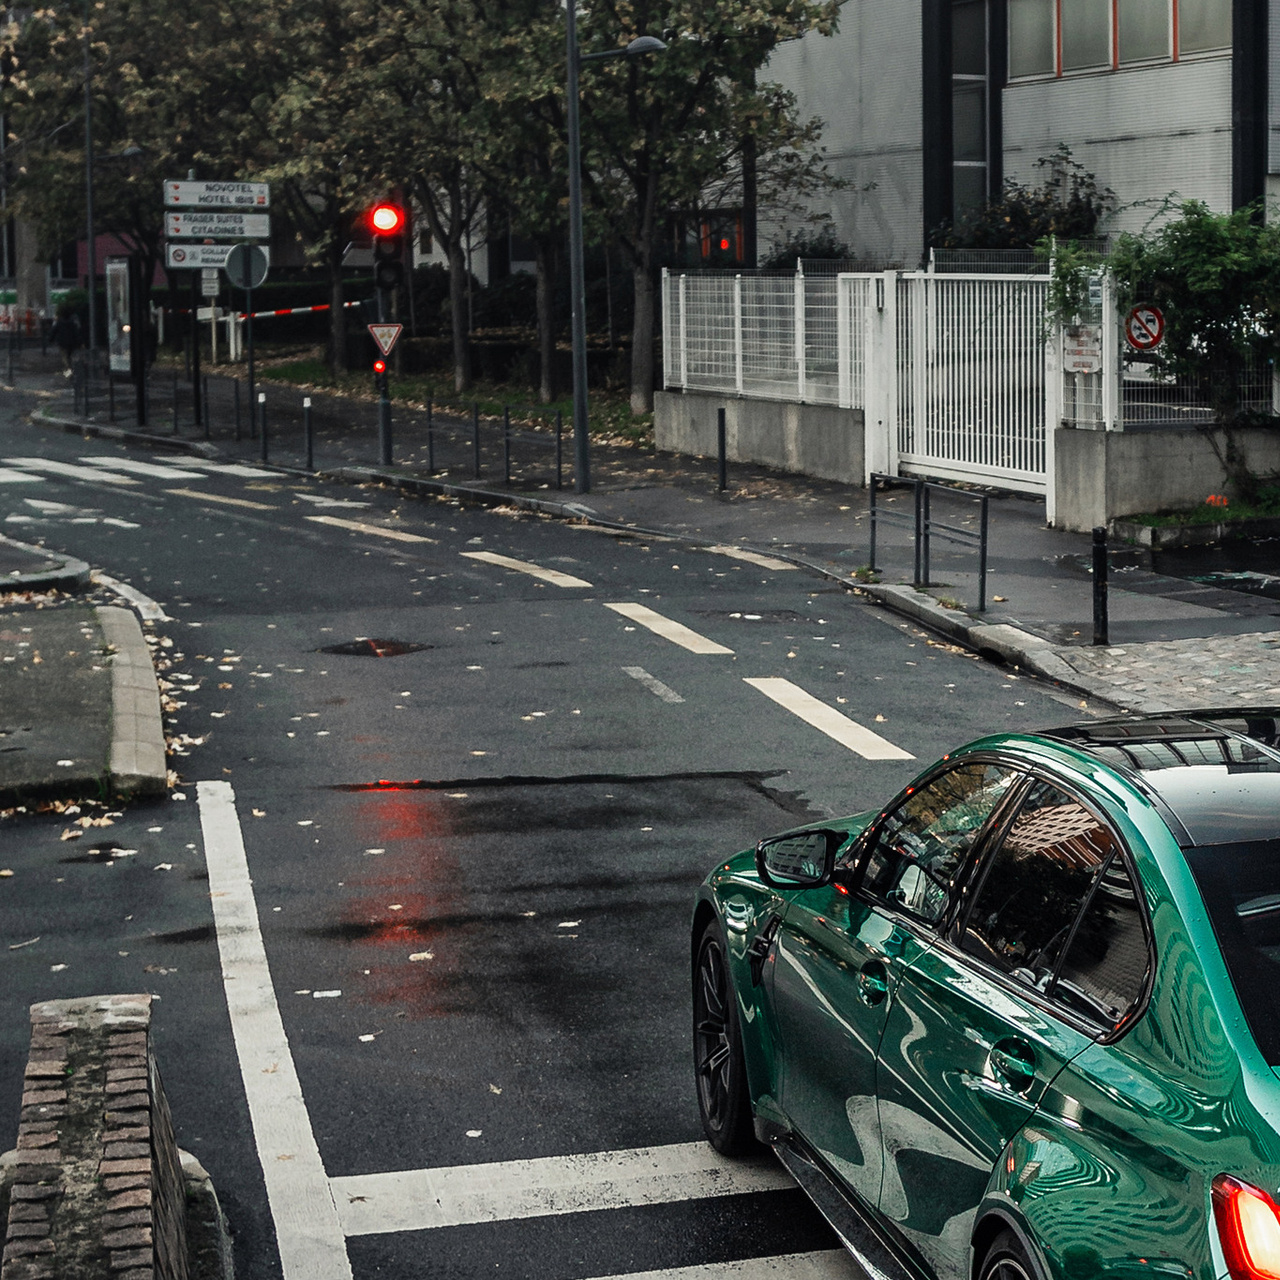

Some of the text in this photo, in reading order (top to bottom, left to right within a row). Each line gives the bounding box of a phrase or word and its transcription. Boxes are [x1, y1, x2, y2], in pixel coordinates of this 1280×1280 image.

[205, 183, 253, 193] NOVOTEL
[198, 195, 232, 204] HOTEL
[234, 196, 254, 204] IBIS
[182, 214, 244, 224] FRASER SUITES
[191, 225, 245, 235] CITADINES
